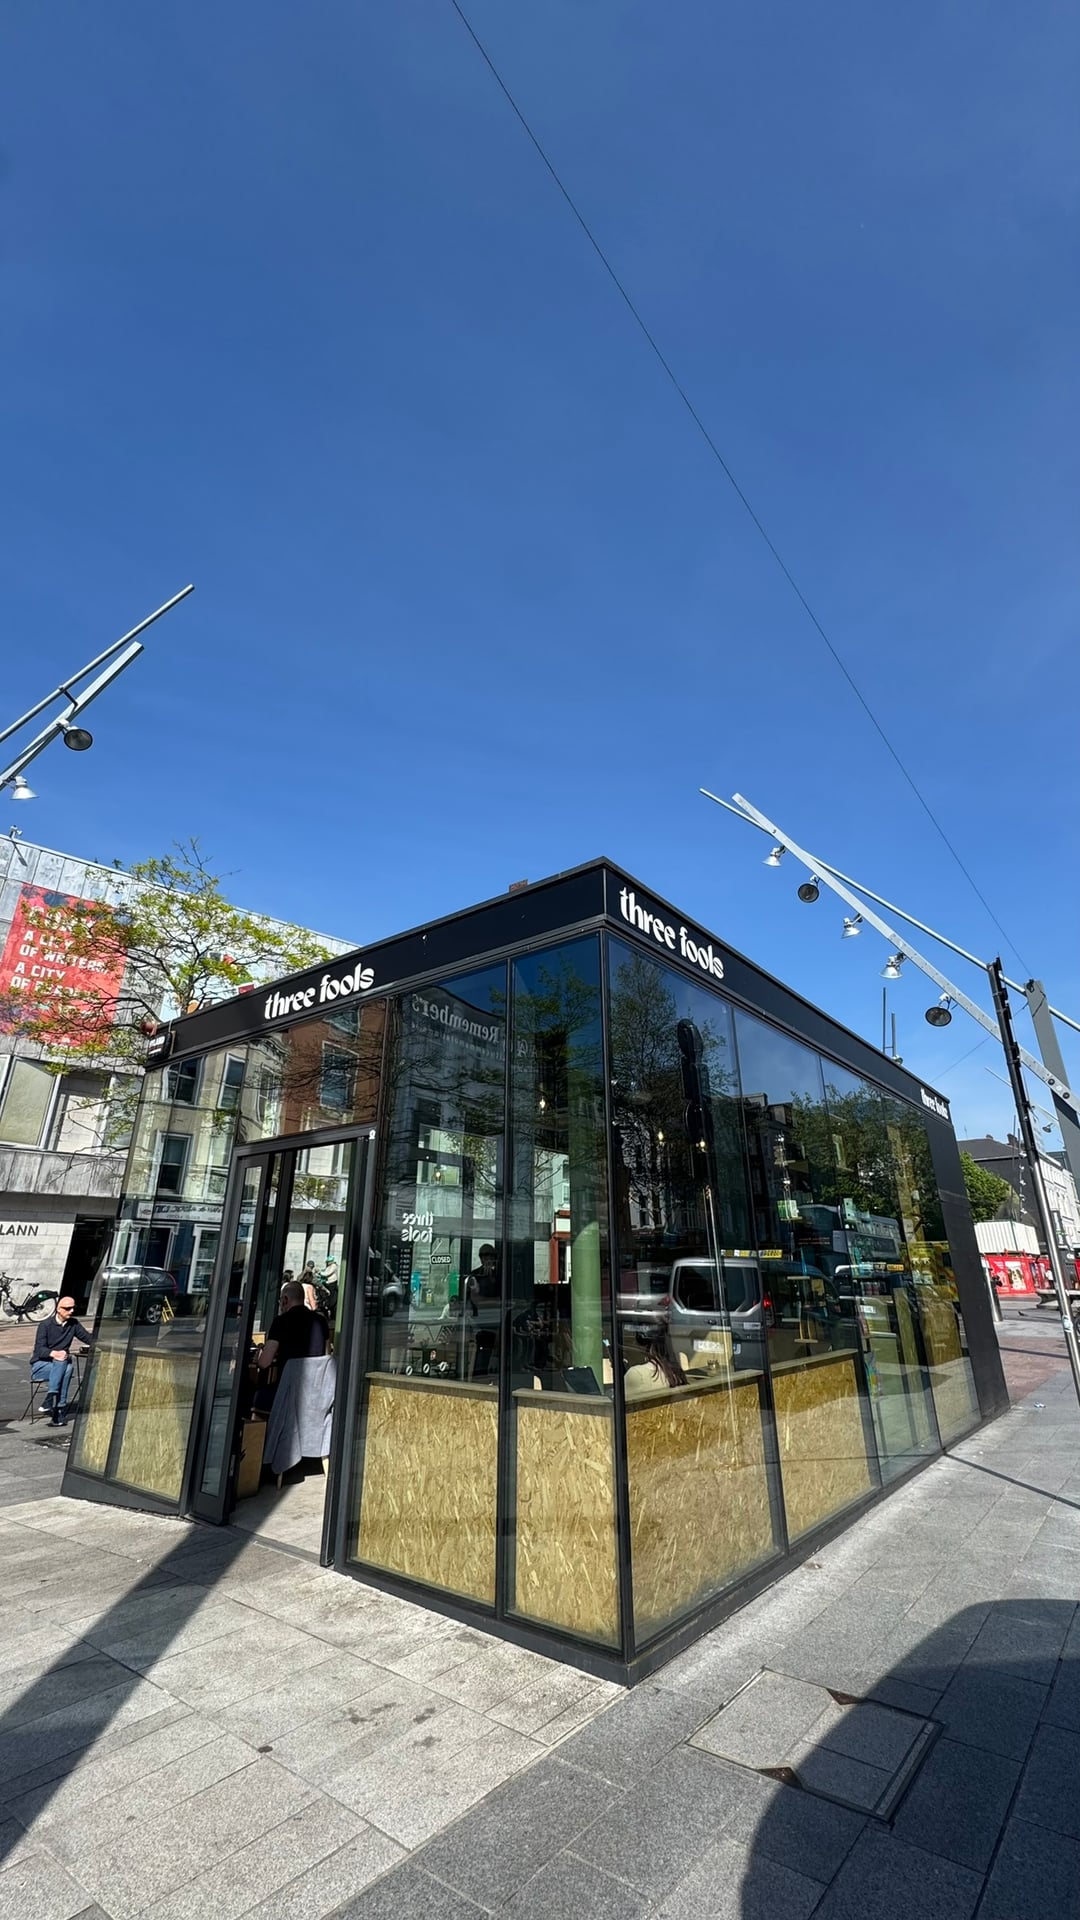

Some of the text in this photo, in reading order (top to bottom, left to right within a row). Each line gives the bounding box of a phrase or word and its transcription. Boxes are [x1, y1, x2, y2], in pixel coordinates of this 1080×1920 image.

[24, 930, 34, 941] A
[619, 887, 724, 979] three fools
[19, 945, 39, 958] OF
[15, 962, 66, 980] A CITY
[10, 976, 31, 990] OF
[264, 963, 375, 1019] three fools
[431, 1256, 451, 1264] CLOSED
